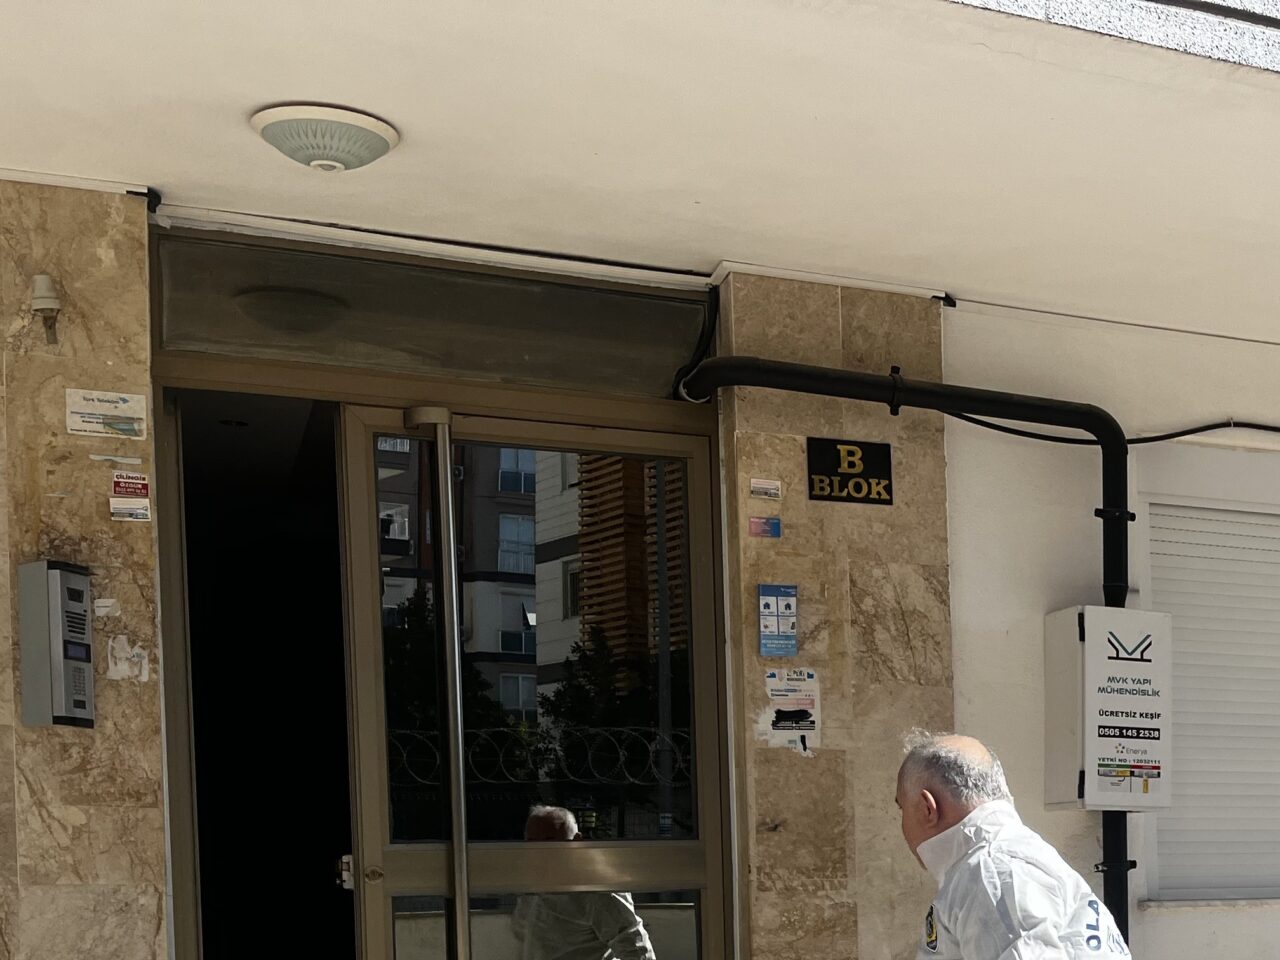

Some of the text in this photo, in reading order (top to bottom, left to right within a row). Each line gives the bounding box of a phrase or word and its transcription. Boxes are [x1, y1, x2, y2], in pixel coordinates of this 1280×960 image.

[837, 444, 864, 473] B
[811, 475, 890, 499] BLOK
[1107, 676, 1152, 686] MVK YAPI
[1097, 685, 1160, 697] MÜHENDİSLİK
[1099, 708, 1162, 720] ÜCRETSİZ KEŞİF
[1099, 728, 1159, 738] 0505 145 2538
[1086, 900, 1101, 951] OLA
